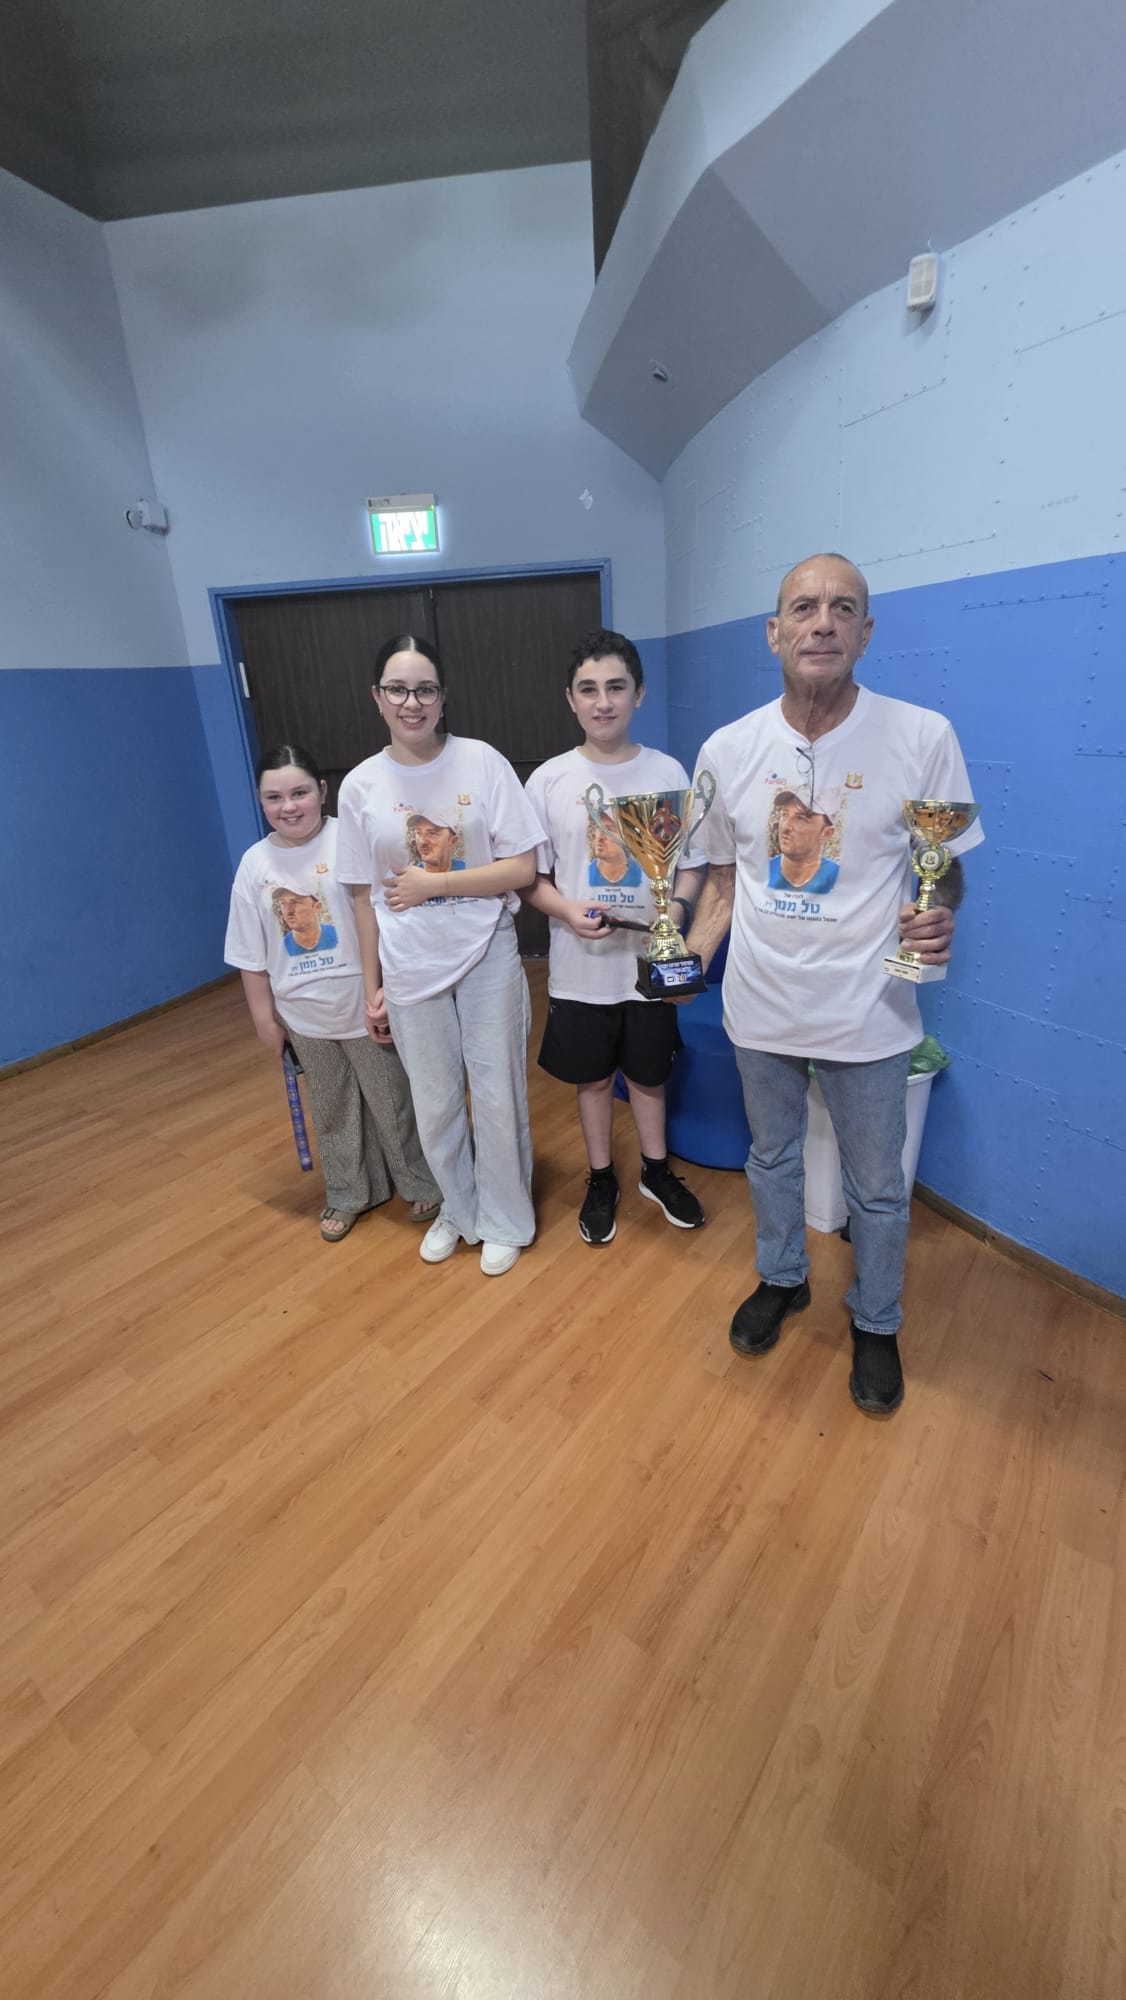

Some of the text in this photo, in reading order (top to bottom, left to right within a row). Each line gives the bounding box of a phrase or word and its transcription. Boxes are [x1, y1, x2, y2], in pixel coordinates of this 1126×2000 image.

[620, 892, 635, 903] טל
[774, 899, 797, 912] ממן
[801, 899, 820, 914] טל
[299, 959, 317, 972] ממן
[318, 956, 334, 966] טל
